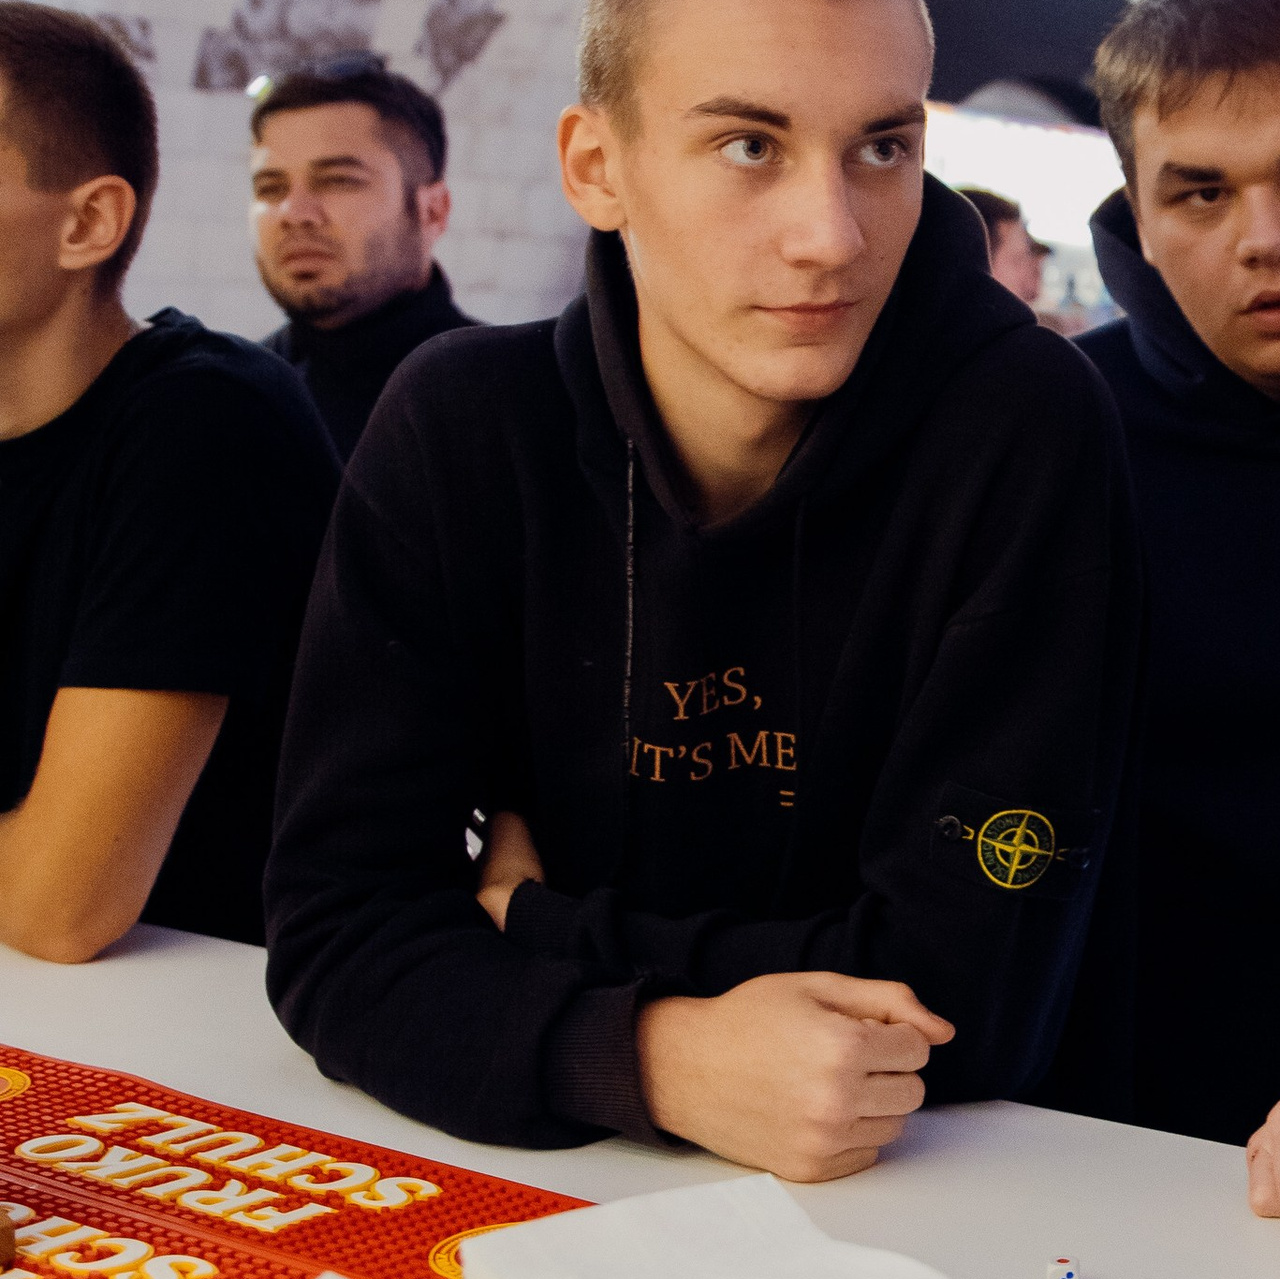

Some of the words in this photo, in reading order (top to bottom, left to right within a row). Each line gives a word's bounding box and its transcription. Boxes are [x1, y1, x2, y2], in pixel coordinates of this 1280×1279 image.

[664, 666, 763, 721] YES,
[629, 736, 714, 783] IT'S
[726, 730, 799, 772] ME
[14, 1133, 338, 1233] FRUKO
[66, 1102, 443, 1210] SCHULZ
